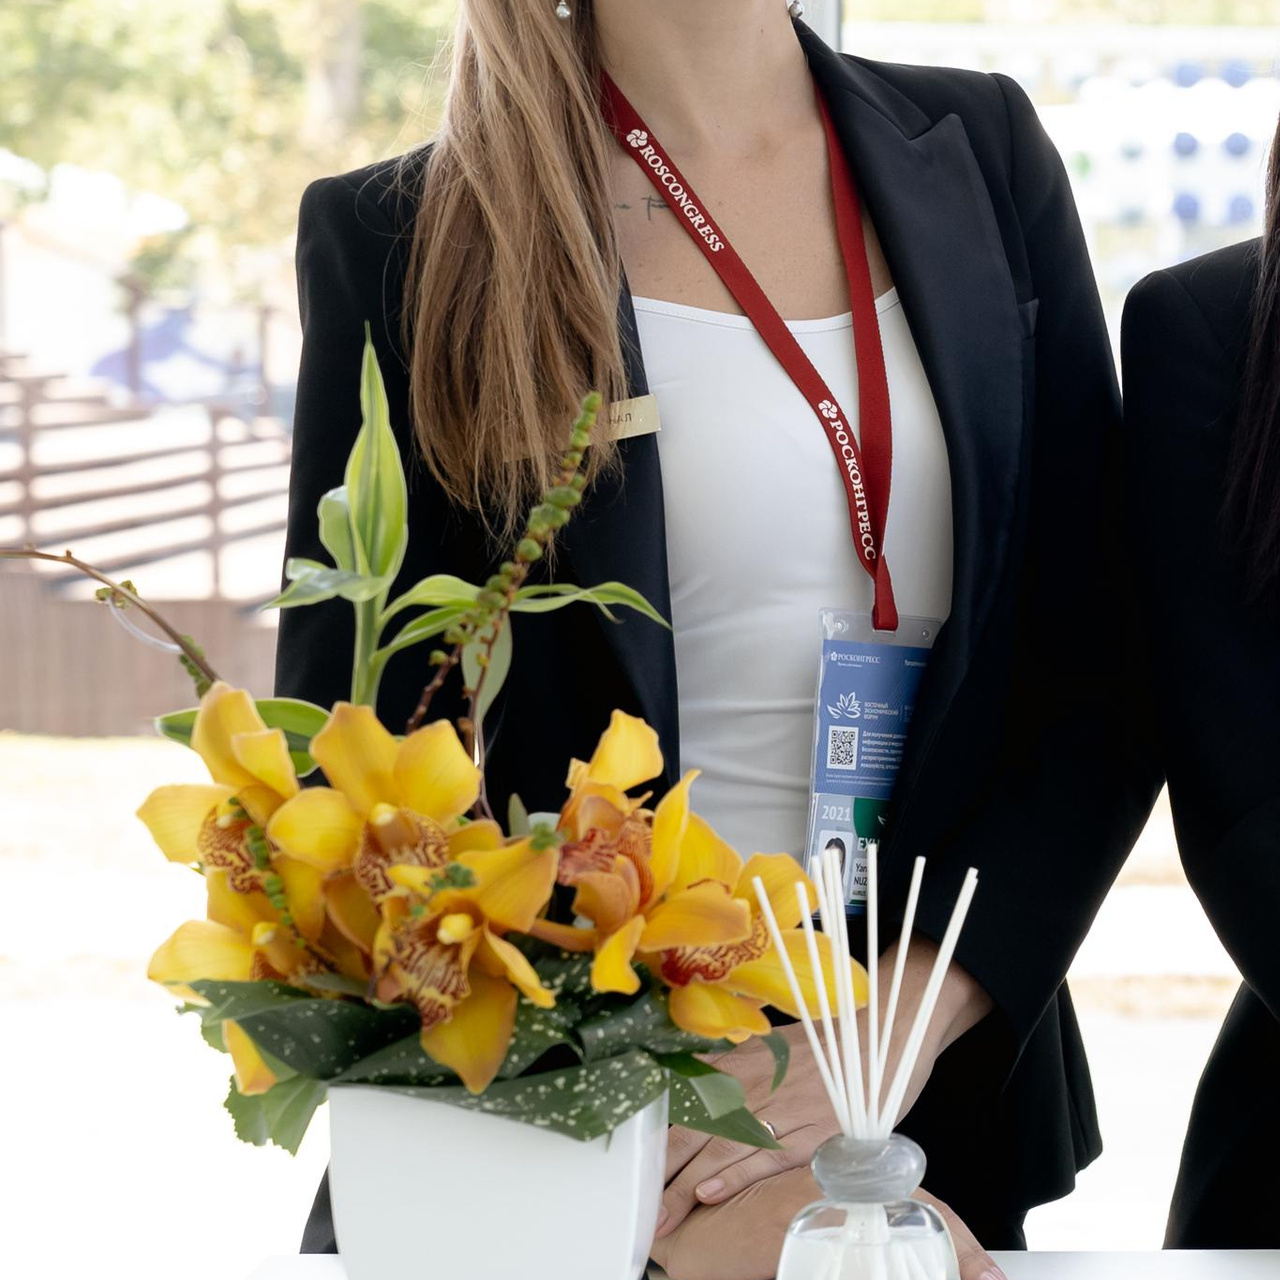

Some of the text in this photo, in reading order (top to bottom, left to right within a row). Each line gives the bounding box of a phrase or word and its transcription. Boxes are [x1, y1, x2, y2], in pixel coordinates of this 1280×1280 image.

[639, 144, 725, 253] ROSCONGRESS
[830, 419, 877, 561] РОСКОНГРЕСС
[822, 805, 851, 821] 2021
